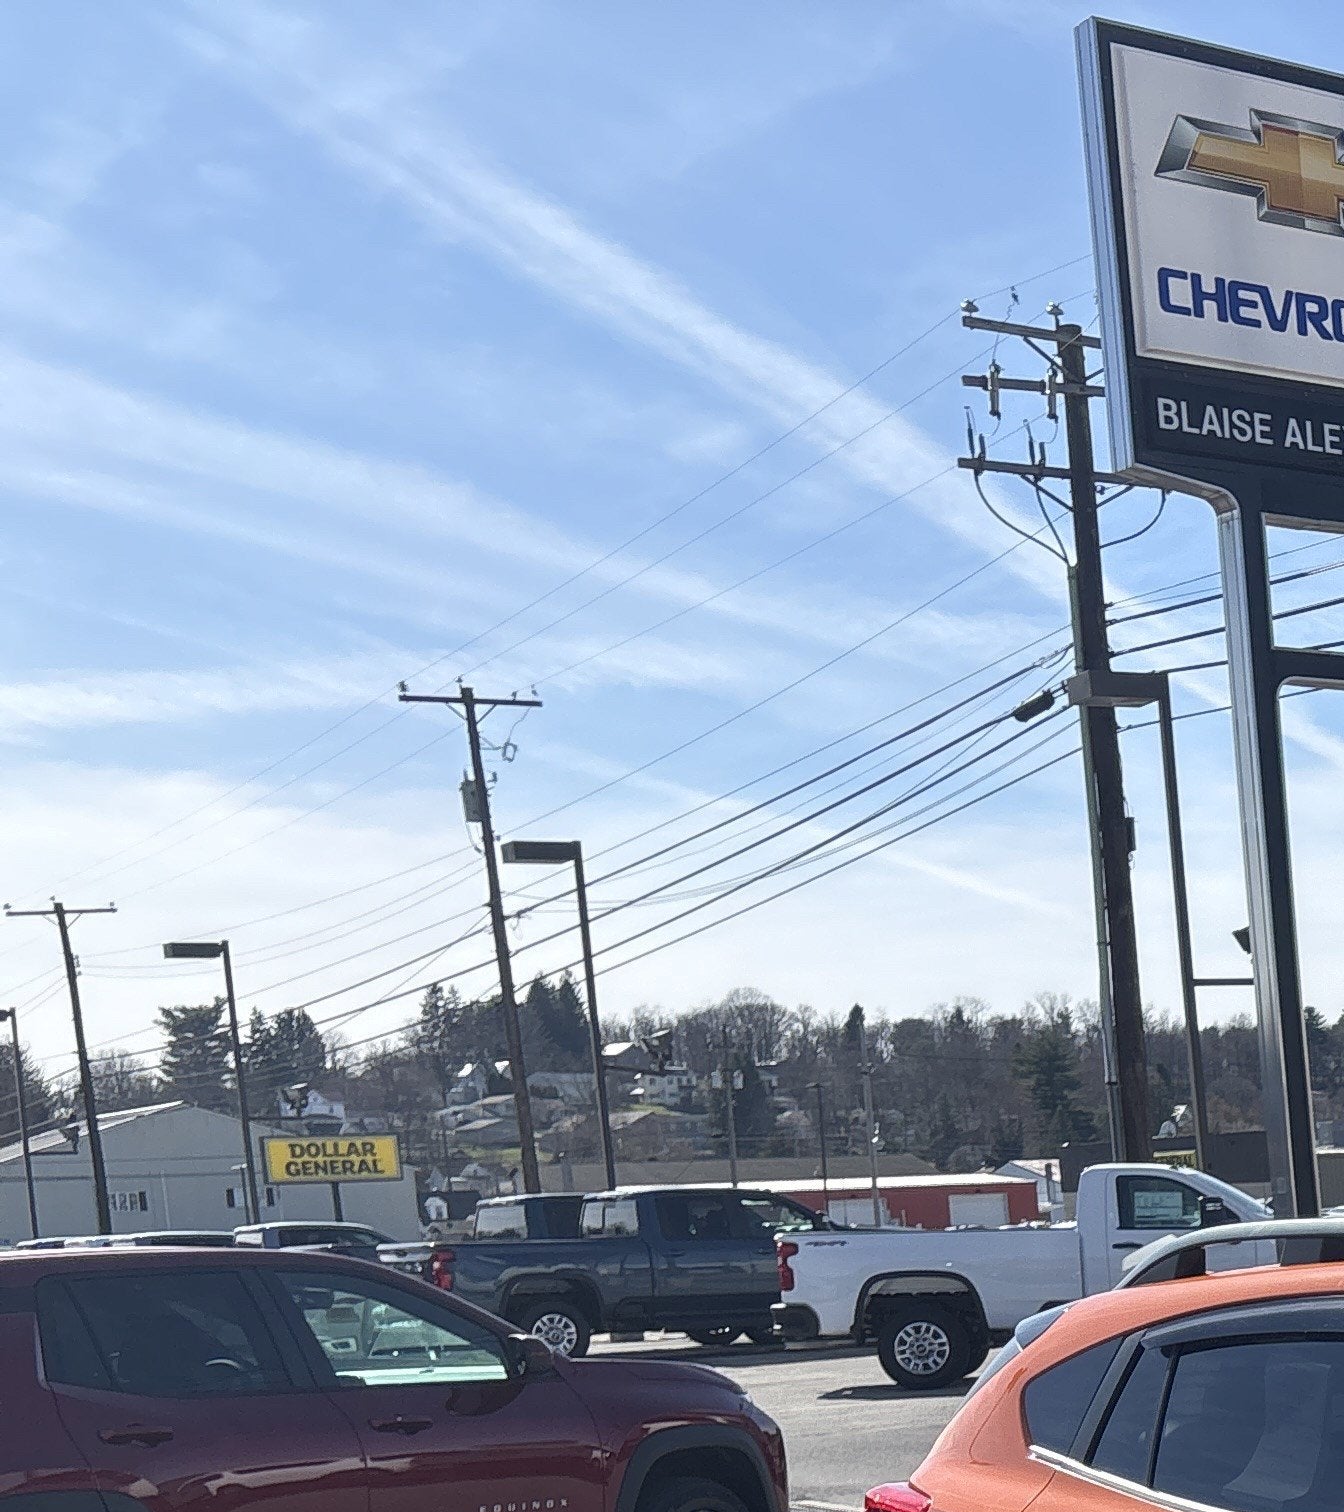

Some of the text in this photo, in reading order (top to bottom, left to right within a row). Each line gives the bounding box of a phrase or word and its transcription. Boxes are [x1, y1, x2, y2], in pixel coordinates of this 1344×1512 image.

[1157, 398, 1273, 446] BLAISE
[288, 1142, 377, 1158] DOLLAR
[285, 1159, 385, 1176] GENERAL
